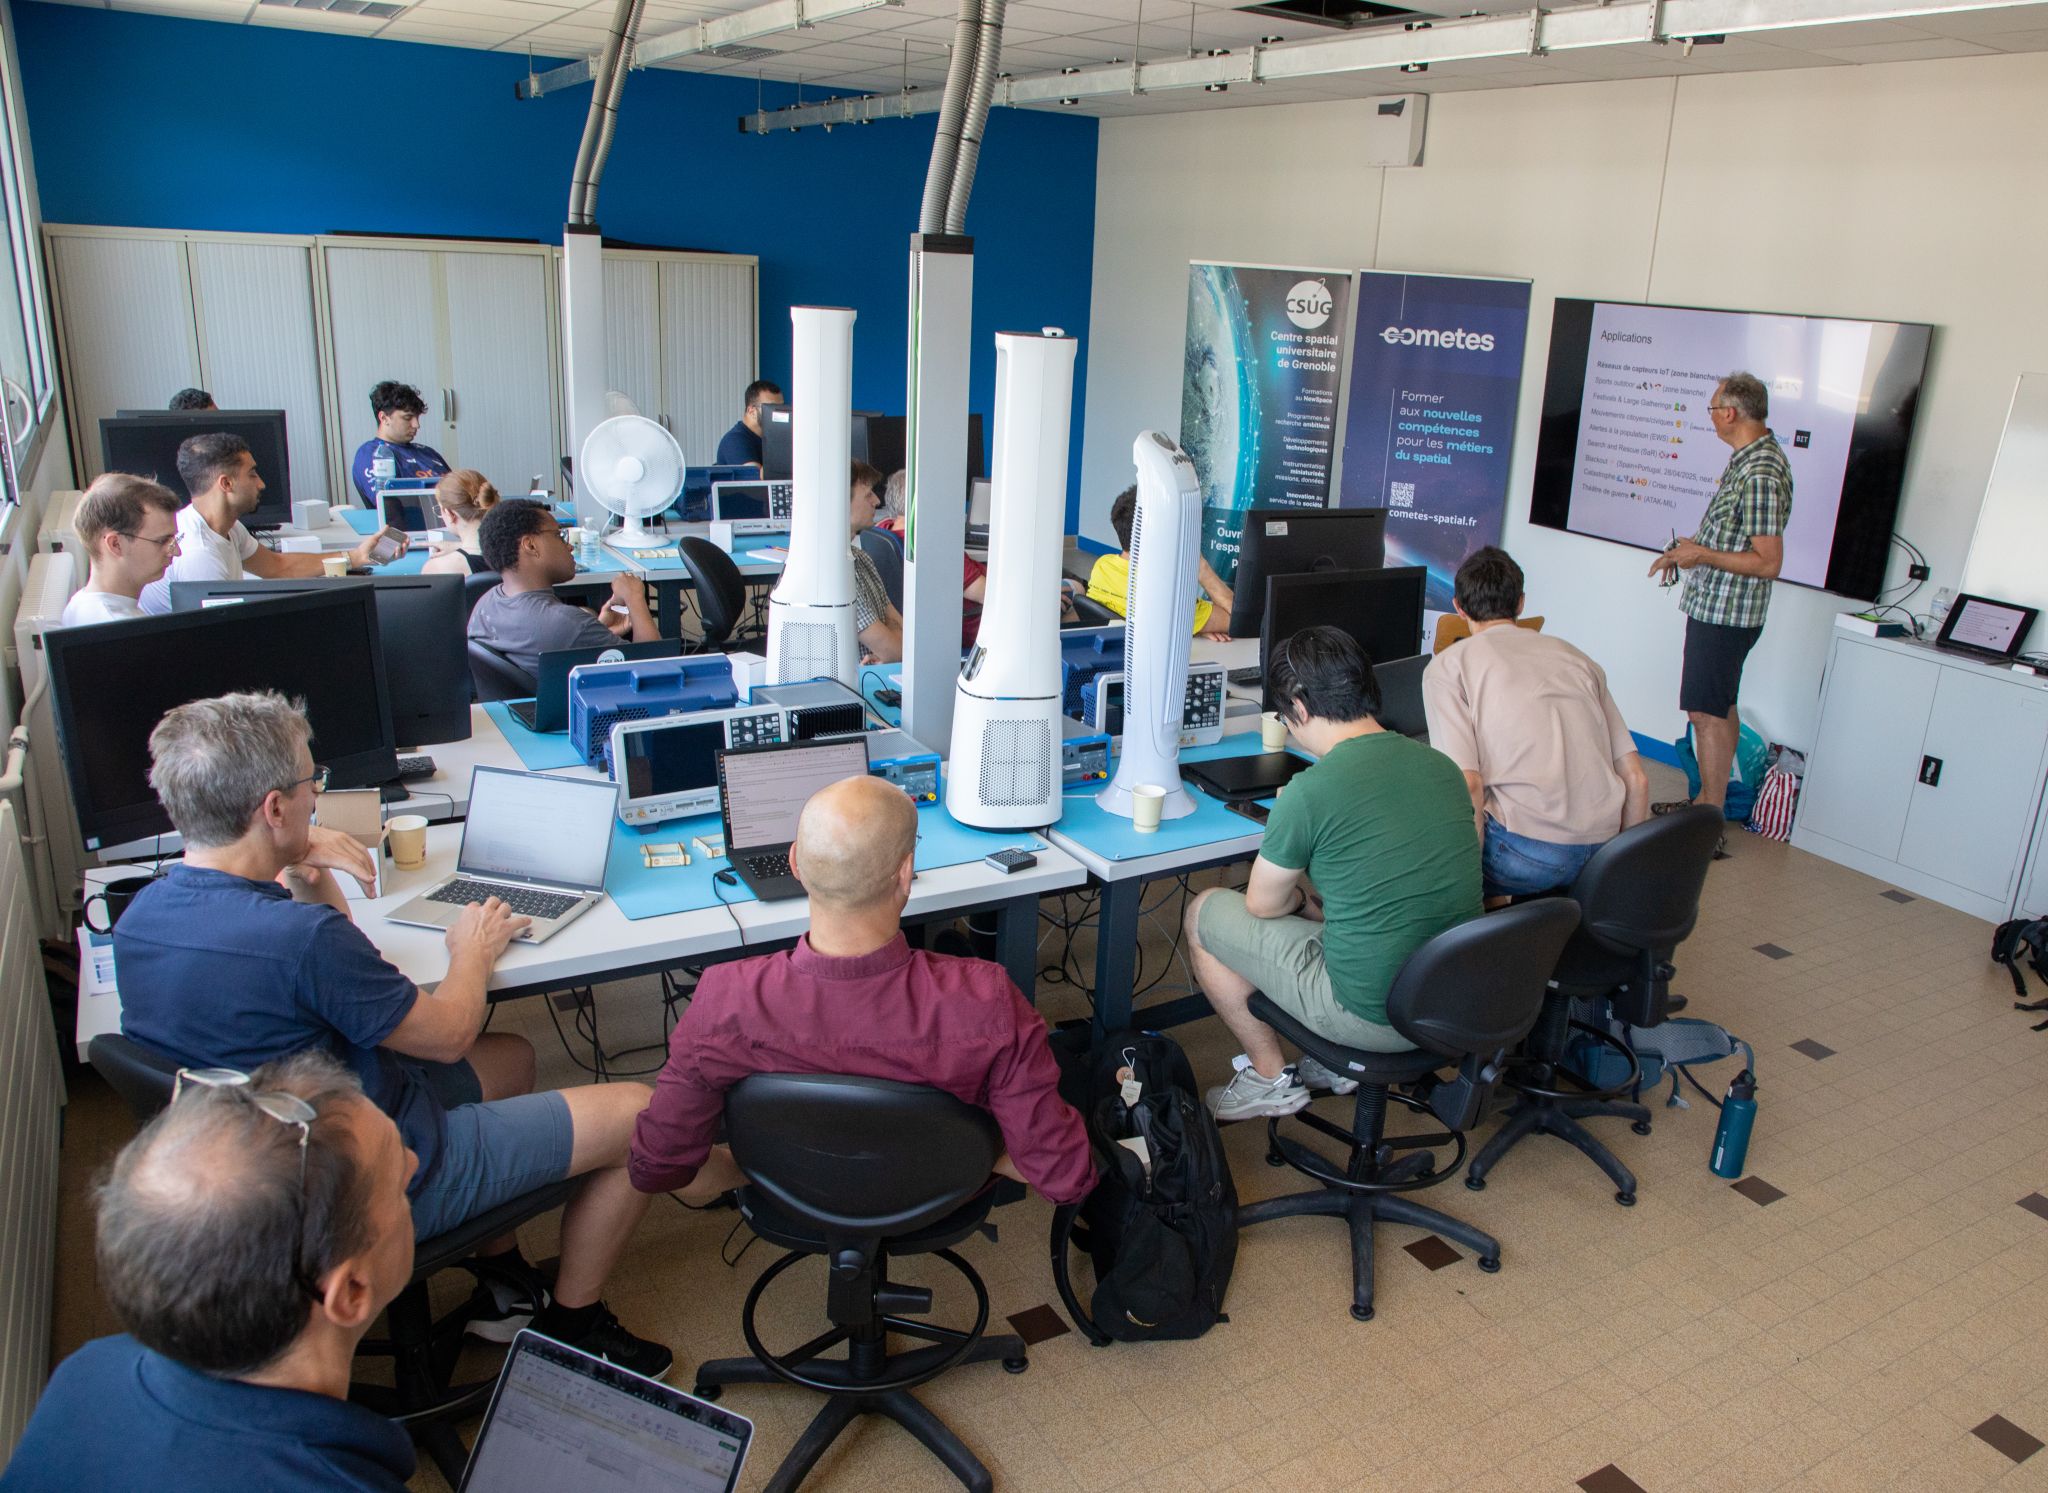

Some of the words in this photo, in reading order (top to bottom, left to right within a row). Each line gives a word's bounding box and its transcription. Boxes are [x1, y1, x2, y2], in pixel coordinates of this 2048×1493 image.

[1286, 298, 1332, 316] CSUG
[1270, 331, 1303, 342] Centre
[1305, 335, 1338, 346] spatial
[1379, 326, 1495, 352] cometes
[1600, 330, 1652, 345] Applications
[1276, 346, 1337, 359] universitaire
[1277, 358, 1290, 368] de
[1291, 360, 1336, 372] Grenoble
[1597, 361, 1622, 370] Réseaux
[1631, 366, 1658, 374] capteurs
[1659, 368, 1670, 376] IoT
[1671, 370, 1688, 378] (zone
[1301, 387, 1333, 396] Formations
[1401, 390, 1444, 404] Former
[1662, 384, 1679, 394] (zone
[1680, 385, 1707, 398] blanche)
[1303, 395, 1333, 404] NewSpace
[1623, 396, 1640, 406] Large
[1287, 412, 1322, 421] Programmes
[1399, 407, 1420, 417] aux
[1423, 409, 1482, 423] nouvelles
[1590, 408, 1625, 419] Mouvements
[1275, 419, 1302, 427] recherche
[1398, 422, 1480, 437] compétences
[1283, 436, 1328, 447] Développements
[1619, 429, 1649, 439] population
[1649, 432, 1669, 442] (EWS)
[1285, 443, 1328, 454] technologiques
[1396, 436, 1424, 448] pour
[1426, 437, 1444, 449] les
[1446, 441, 1494, 455] métiers
[1587, 439, 1606, 449] Search
[1606, 442, 1618, 451] and
[1618, 444, 1640, 455] Rescue
[1395, 449, 1410, 460] du
[1412, 452, 1452, 465] spatial
[1282, 460, 1326, 470] Instrumentation
[1585, 454, 1608, 465] Blackout
[1699, 474, 1713, 484] next
[1286, 491, 1315, 500] Innovation
[1602, 487, 1611, 495] de
[1611, 489, 1629, 500] guerre
[1651, 480, 1667, 490] Crise
[1668, 483, 1704, 497] Humanitaire
[1269, 497, 1288, 505] service
[1302, 500, 1323, 509] société
[1388, 509, 1477, 527] cometes-spatial.fr
